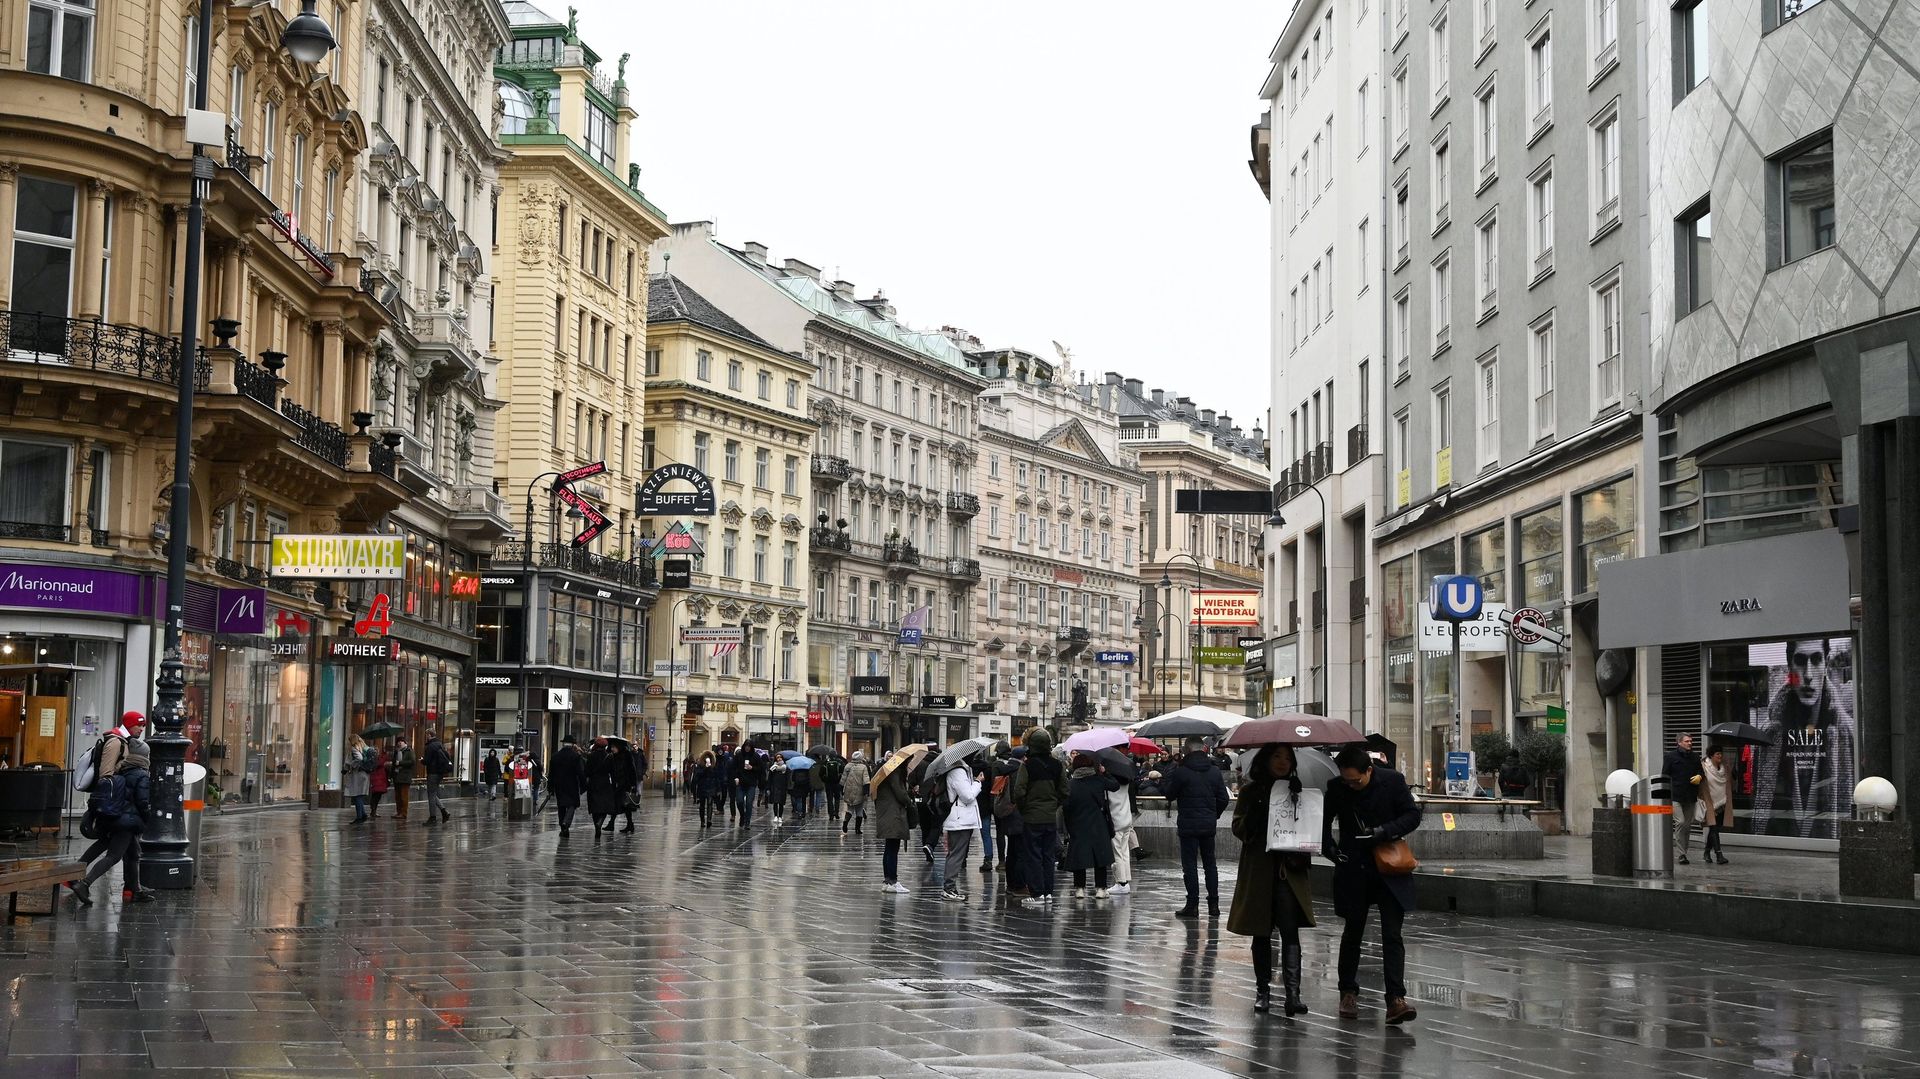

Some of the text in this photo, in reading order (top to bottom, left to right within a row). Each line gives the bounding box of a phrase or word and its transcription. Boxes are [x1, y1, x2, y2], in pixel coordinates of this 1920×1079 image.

[656, 495, 697, 504] BUFFET
[281, 538, 396, 567] STURMAYR
[279, 567, 395, 575] COIFFEURE
[0, 571, 94, 594] Marionnaud
[452, 578, 479, 595] H&M
[37, 594, 63, 602] PARIS
[1203, 599, 1245, 607] WIENER
[1447, 583, 1476, 614] U
[1720, 597, 1763, 615] ZARA
[1518, 609, 1545, 625] TABAK
[1424, 625, 1501, 637] L'EUROPE
[1513, 622, 1538, 642] TRAFIK
[333, 643, 387, 657] APOTHEKE
[1101, 652, 1129, 661] Berlitz
[475, 676, 511, 685] ESPRESSO
[1787, 728, 1823, 746] SALE
[1273, 819, 1281, 827] A
